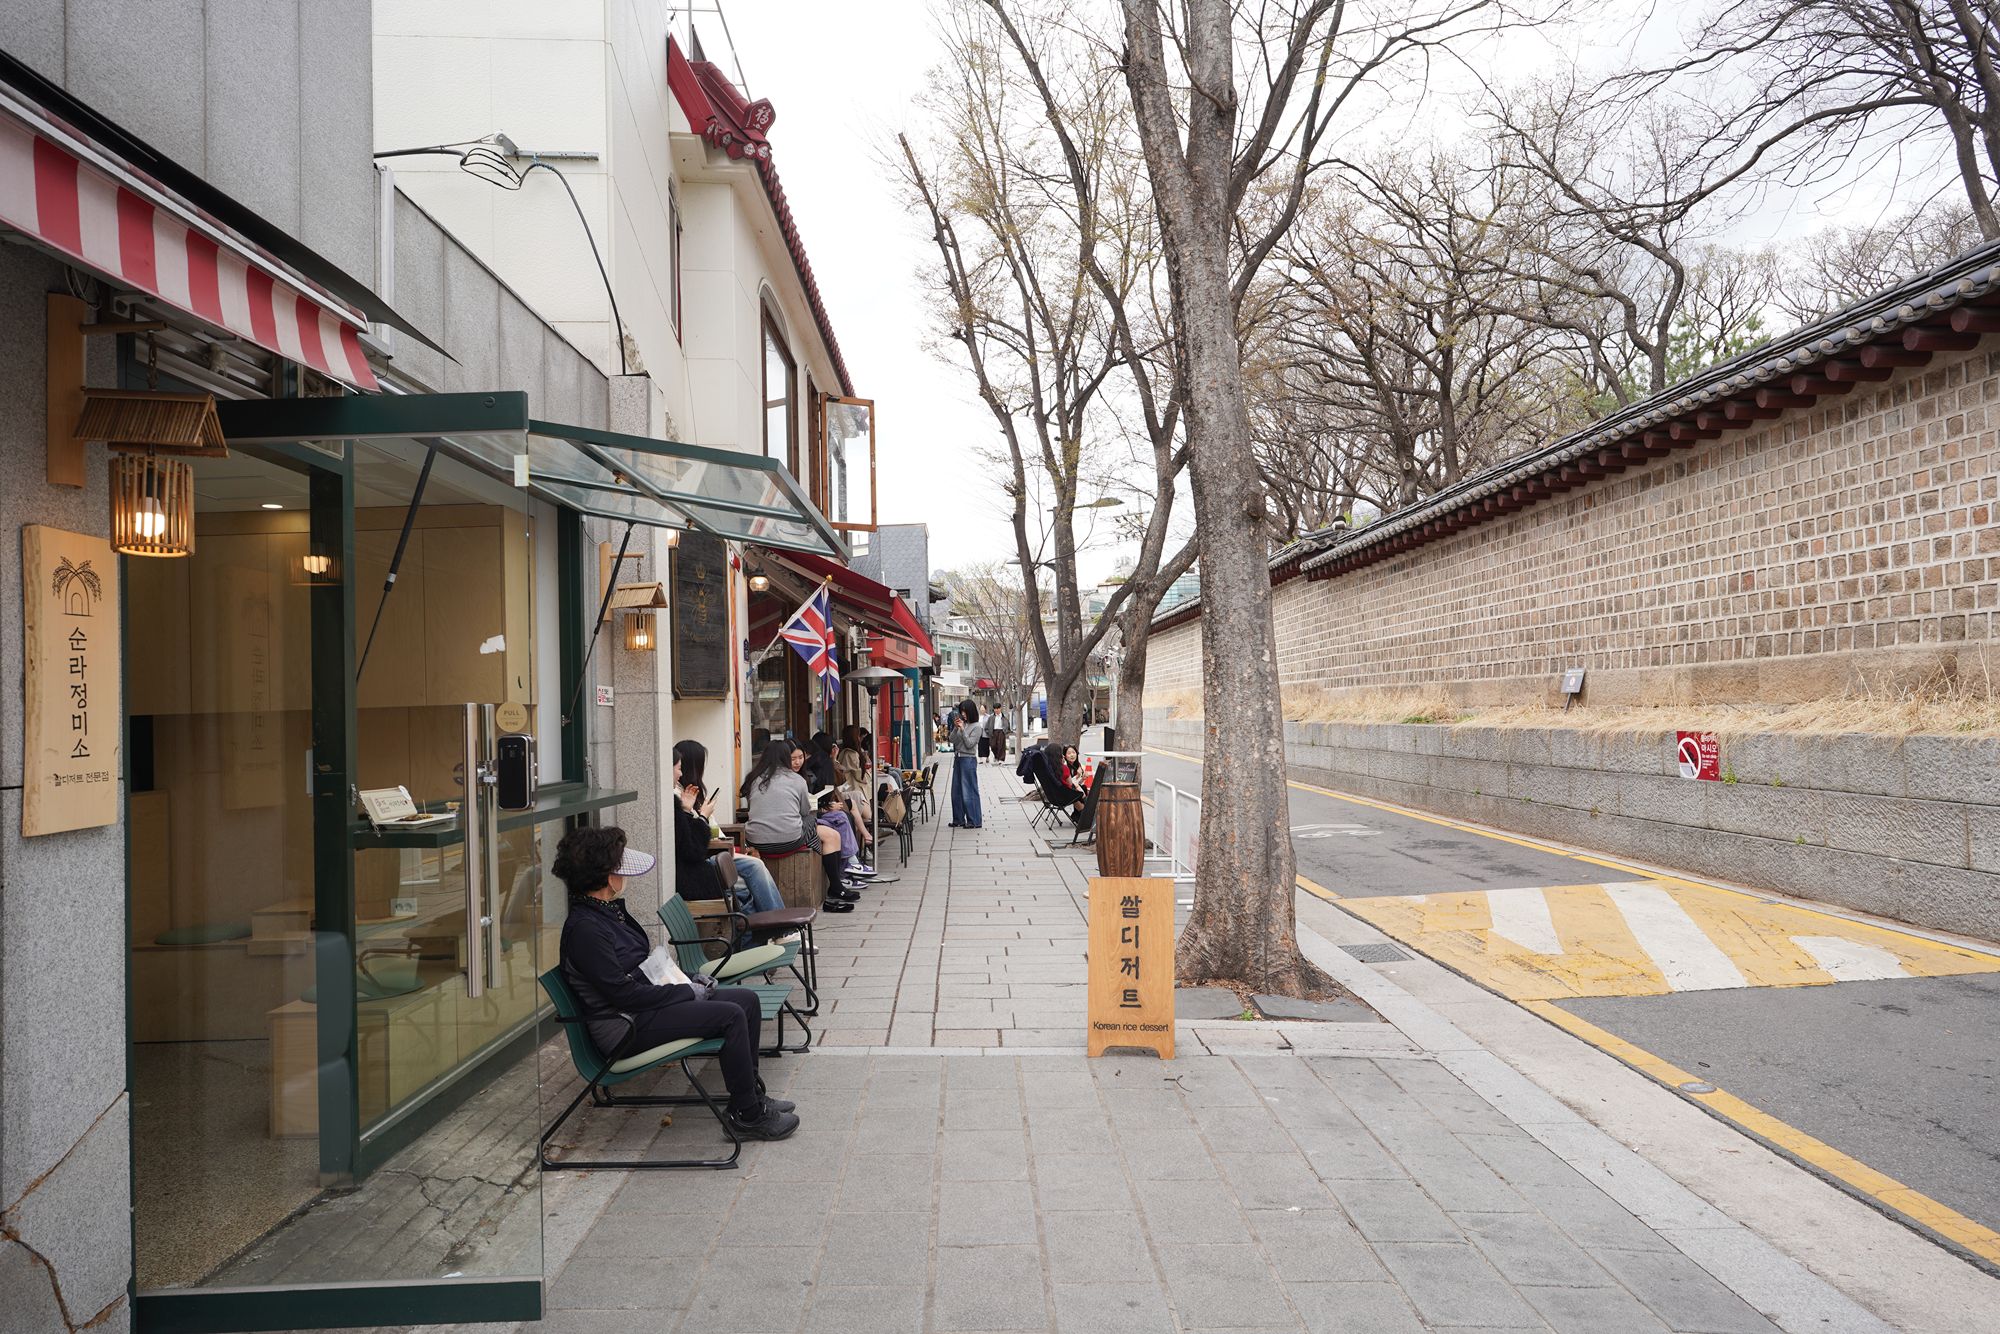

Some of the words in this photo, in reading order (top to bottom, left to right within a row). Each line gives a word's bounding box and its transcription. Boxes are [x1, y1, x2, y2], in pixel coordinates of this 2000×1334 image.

[68, 627, 90, 759] 순라정미소
[1701, 744, 1717, 753] 마시오
[1120, 895, 1142, 1008] 쌀디저트
[1093, 1021, 1120, 1031] Korean
[1122, 1022, 1138, 1031] rice
[1140, 1022, 1169, 1032] dessert
